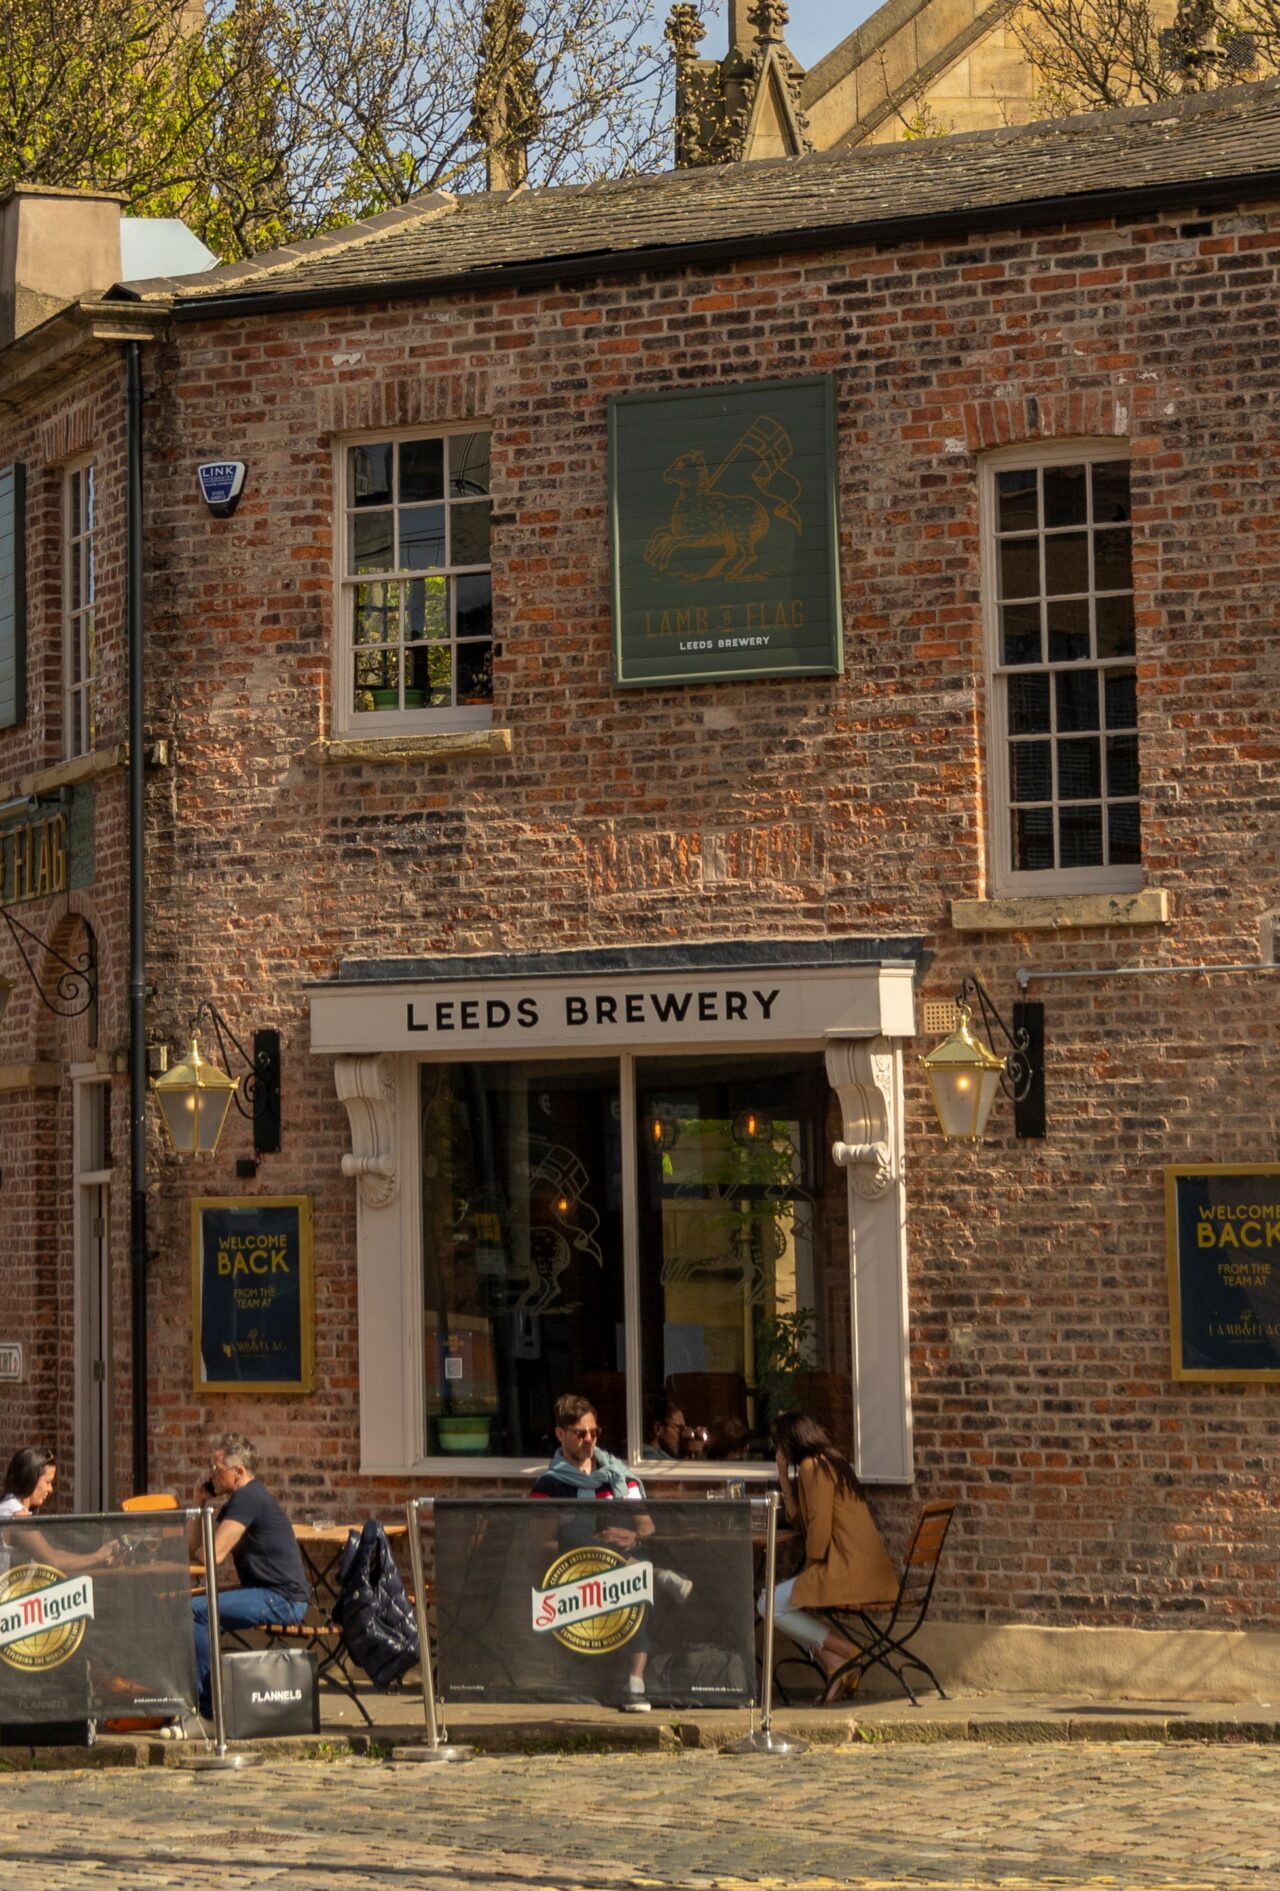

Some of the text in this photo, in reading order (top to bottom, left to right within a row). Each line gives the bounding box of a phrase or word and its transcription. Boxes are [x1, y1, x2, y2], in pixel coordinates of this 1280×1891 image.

[203, 466, 234, 476] LINK
[645, 607, 710, 640] LAMB
[745, 600, 806, 630] FLAG
[679, 636, 770, 651] LEEDS BREWERY
[14, 812, 67, 902] FLAG
[407, 989, 781, 1031] LEEDS BREWERY
[218, 1234, 288, 1249] WELCOME
[1197, 1221, 1280, 1249] BACK
[217, 1249, 290, 1275] BACK
[1218, 1263, 1272, 1275] FROM THE
[1223, 1275, 1267, 1287] TEAM AT
[233, 1287, 277, 1299] FROM THE
[237, 1298, 273, 1309] TEAM AT
[18, 1583, 88, 1626] Miguel
[535, 1568, 648, 1627] San Miguel
[251, 1689, 302, 1703] FLANNELS
